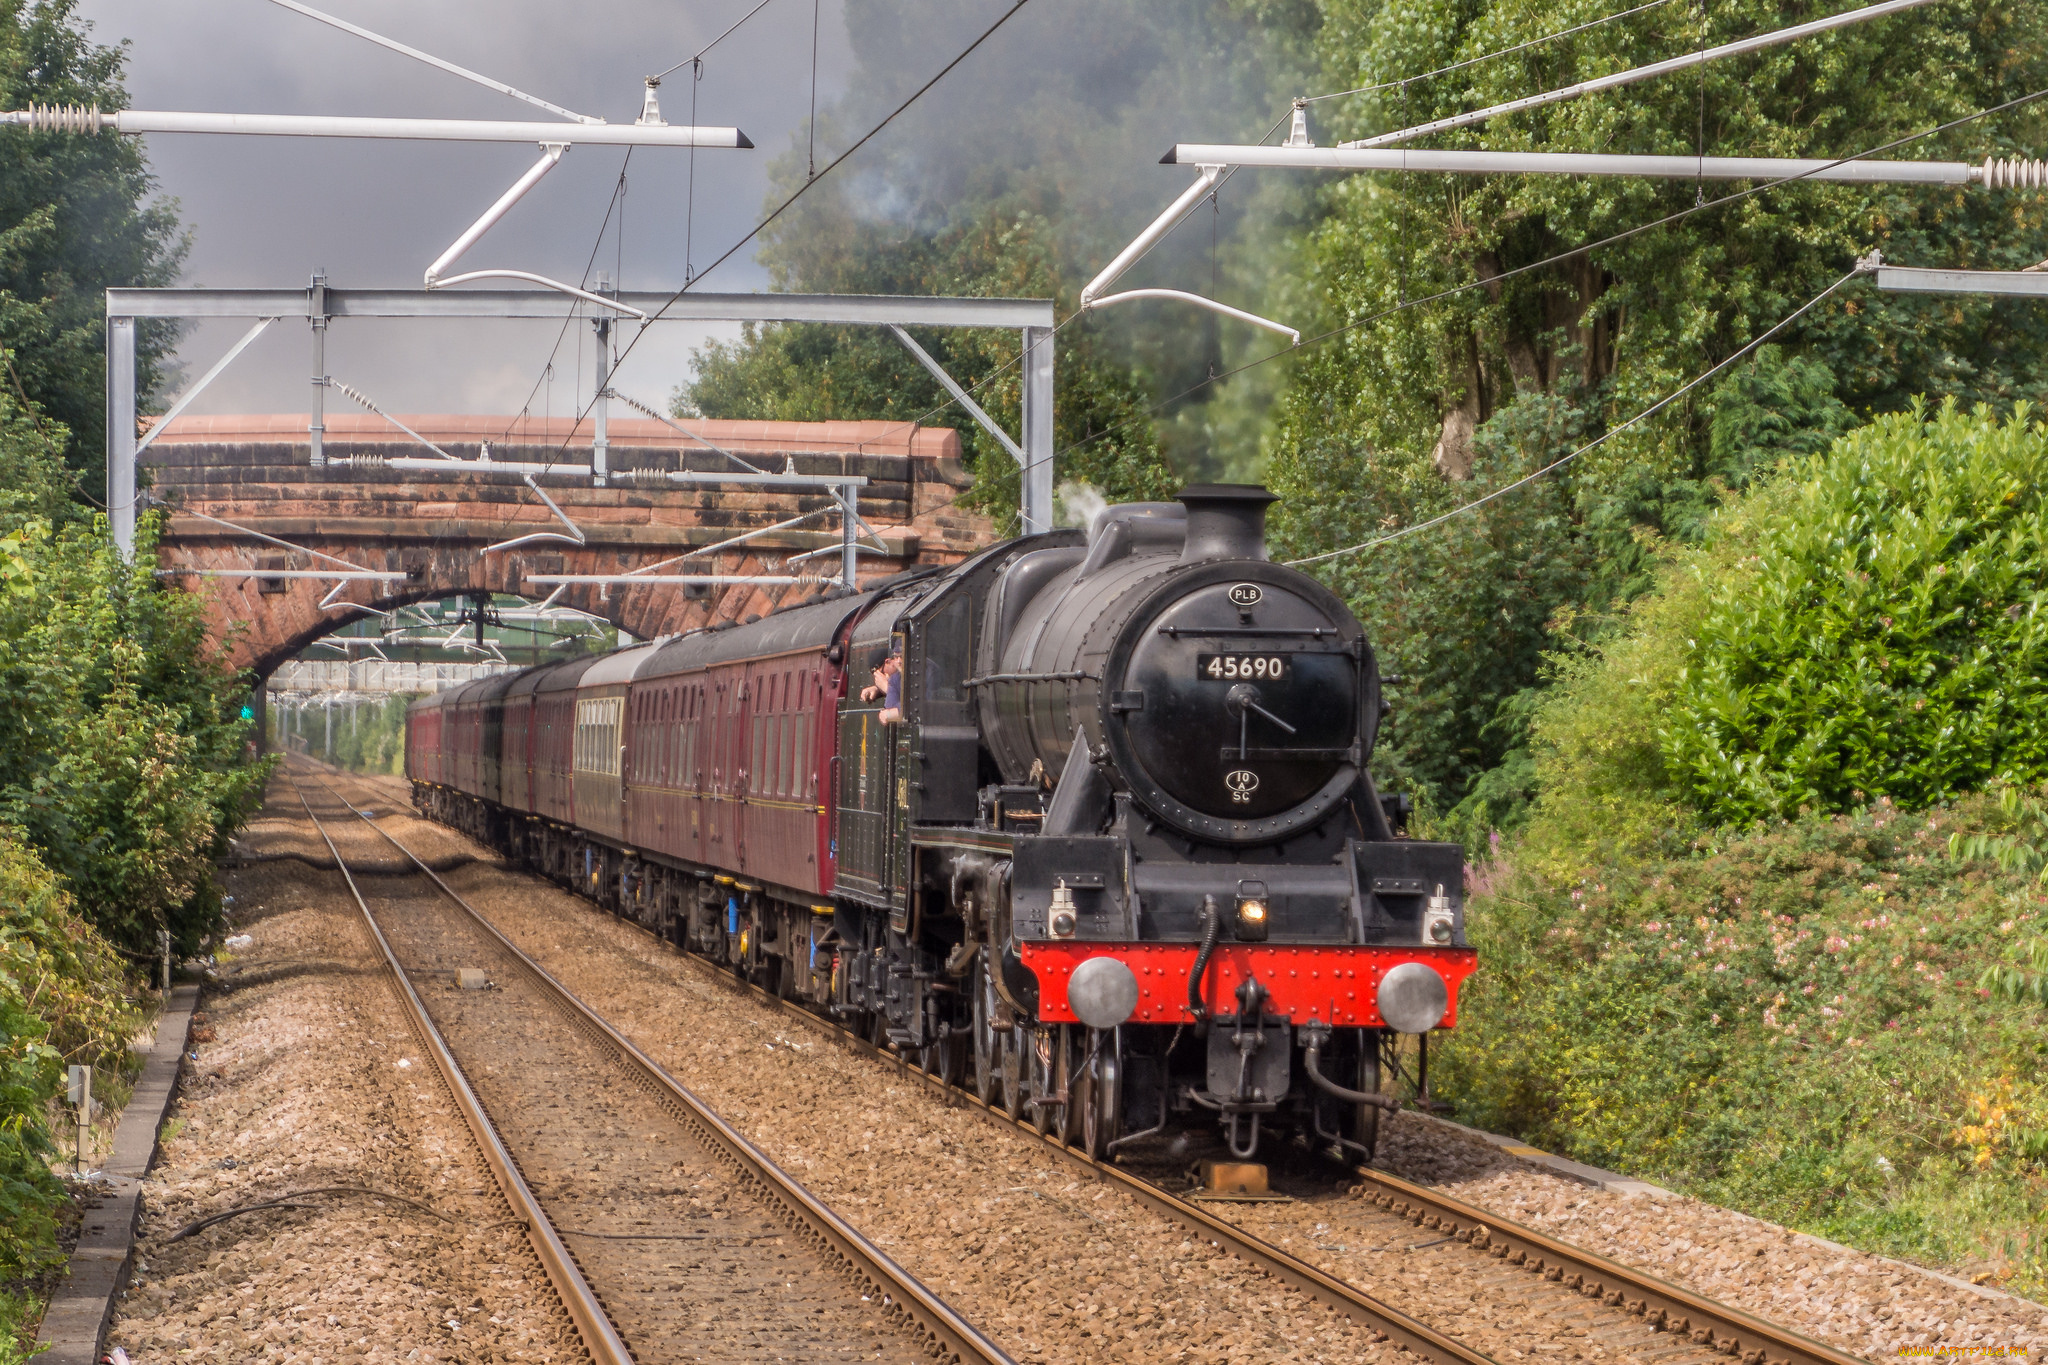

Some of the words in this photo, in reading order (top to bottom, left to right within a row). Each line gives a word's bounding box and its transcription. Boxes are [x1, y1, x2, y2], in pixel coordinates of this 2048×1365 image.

[1235, 589, 1257, 600] PLB
[1207, 656, 1283, 678] 45690
[1237, 772, 1250, 783] 10
[1238, 782, 1246, 790] A
[1233, 791, 1250, 801] SC
